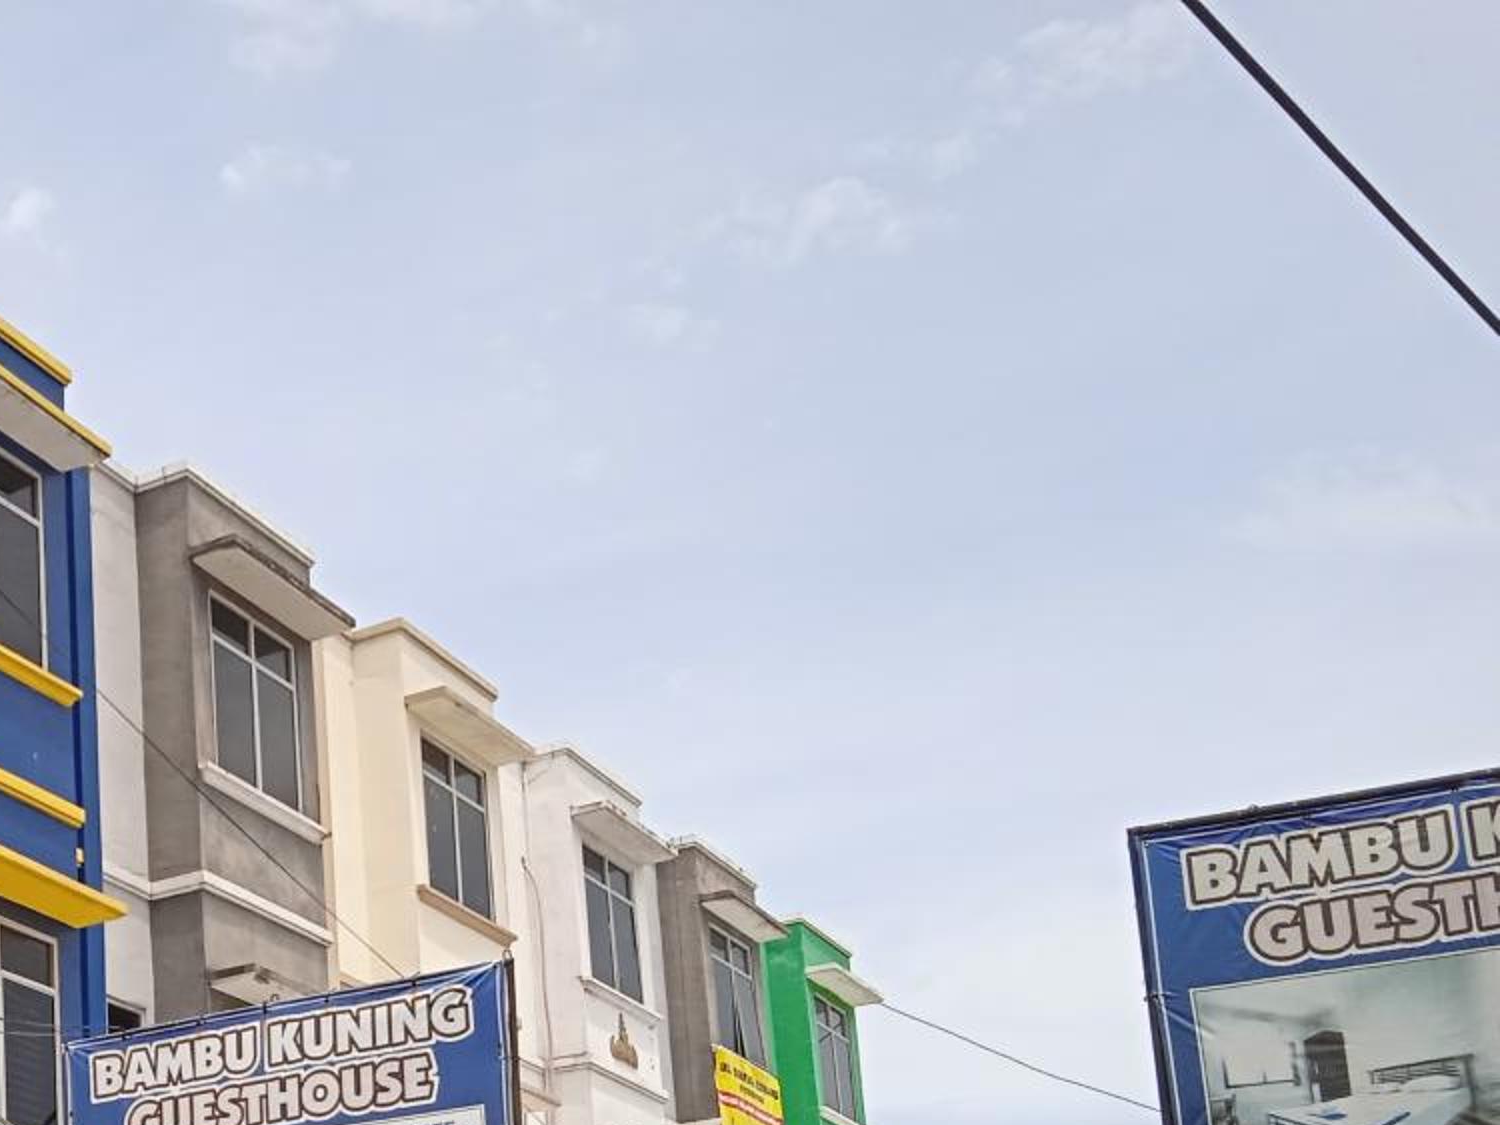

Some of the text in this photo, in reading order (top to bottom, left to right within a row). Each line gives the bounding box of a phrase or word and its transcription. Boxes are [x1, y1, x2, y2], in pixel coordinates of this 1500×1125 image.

[1184, 806, 1455, 909] BAMBU
[90, 987, 472, 1102] BAMBU KUNING
